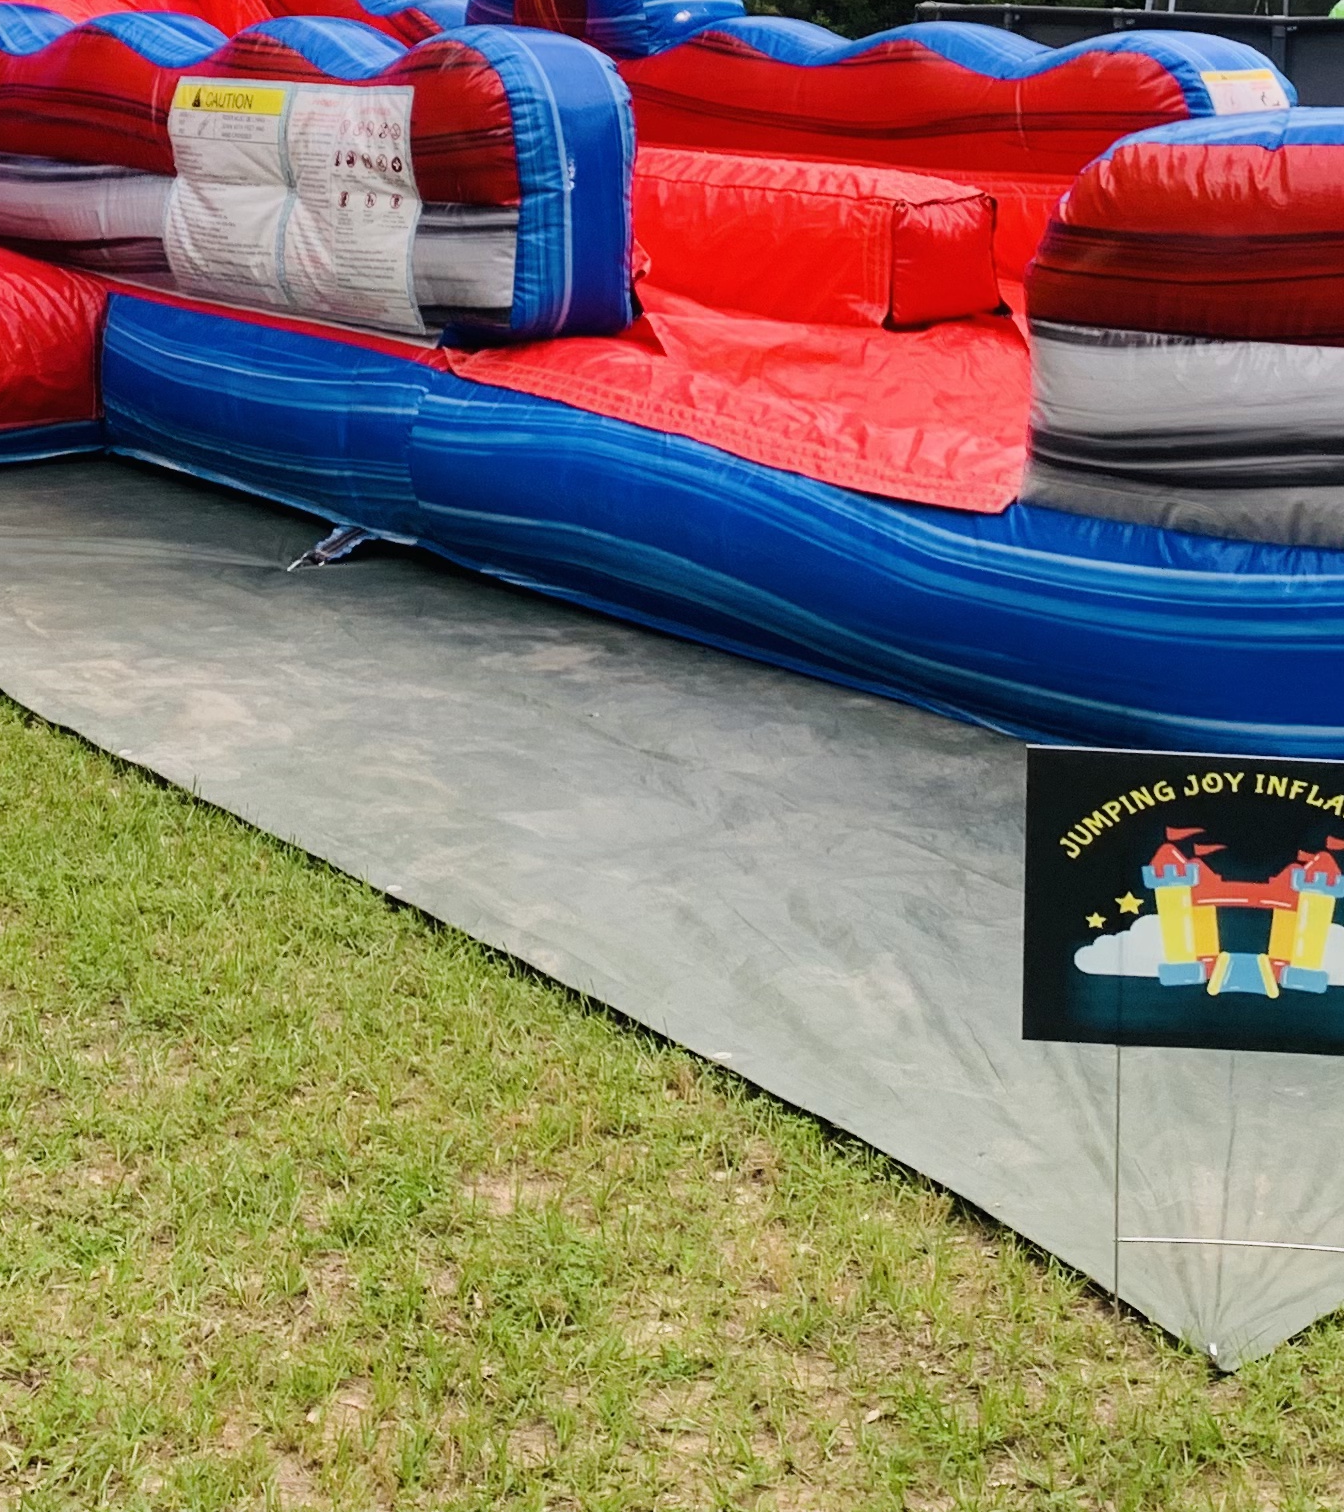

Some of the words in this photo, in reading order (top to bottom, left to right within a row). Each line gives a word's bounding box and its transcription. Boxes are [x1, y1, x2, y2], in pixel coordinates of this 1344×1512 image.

[205, 91, 254, 109] CAUTION
[1059, 780, 1176, 859] JUMPING
[1183, 772, 1245, 797] JOY
